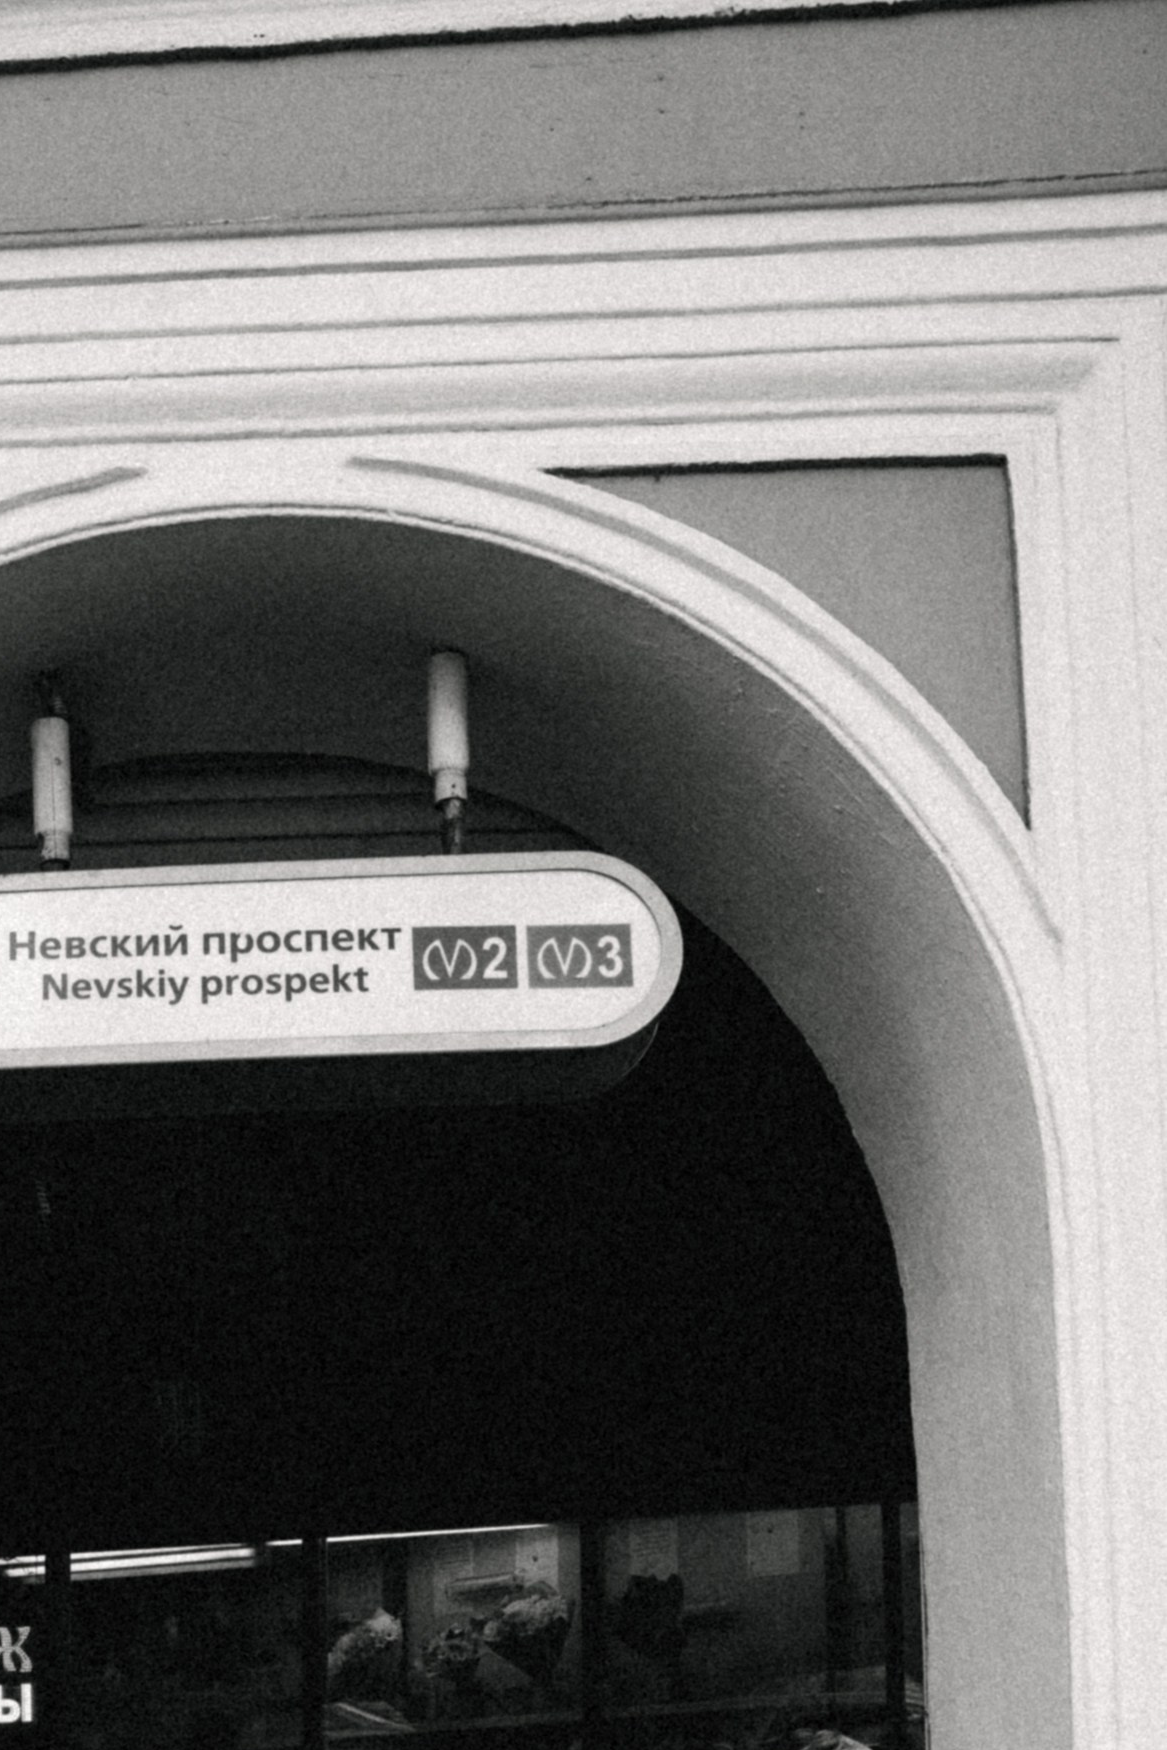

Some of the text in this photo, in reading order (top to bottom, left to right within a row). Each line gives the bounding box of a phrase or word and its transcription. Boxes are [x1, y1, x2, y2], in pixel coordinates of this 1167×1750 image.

[9, 924, 402, 963] Невский проспект
[41, 963, 370, 1006] Nevskiy prospekt
